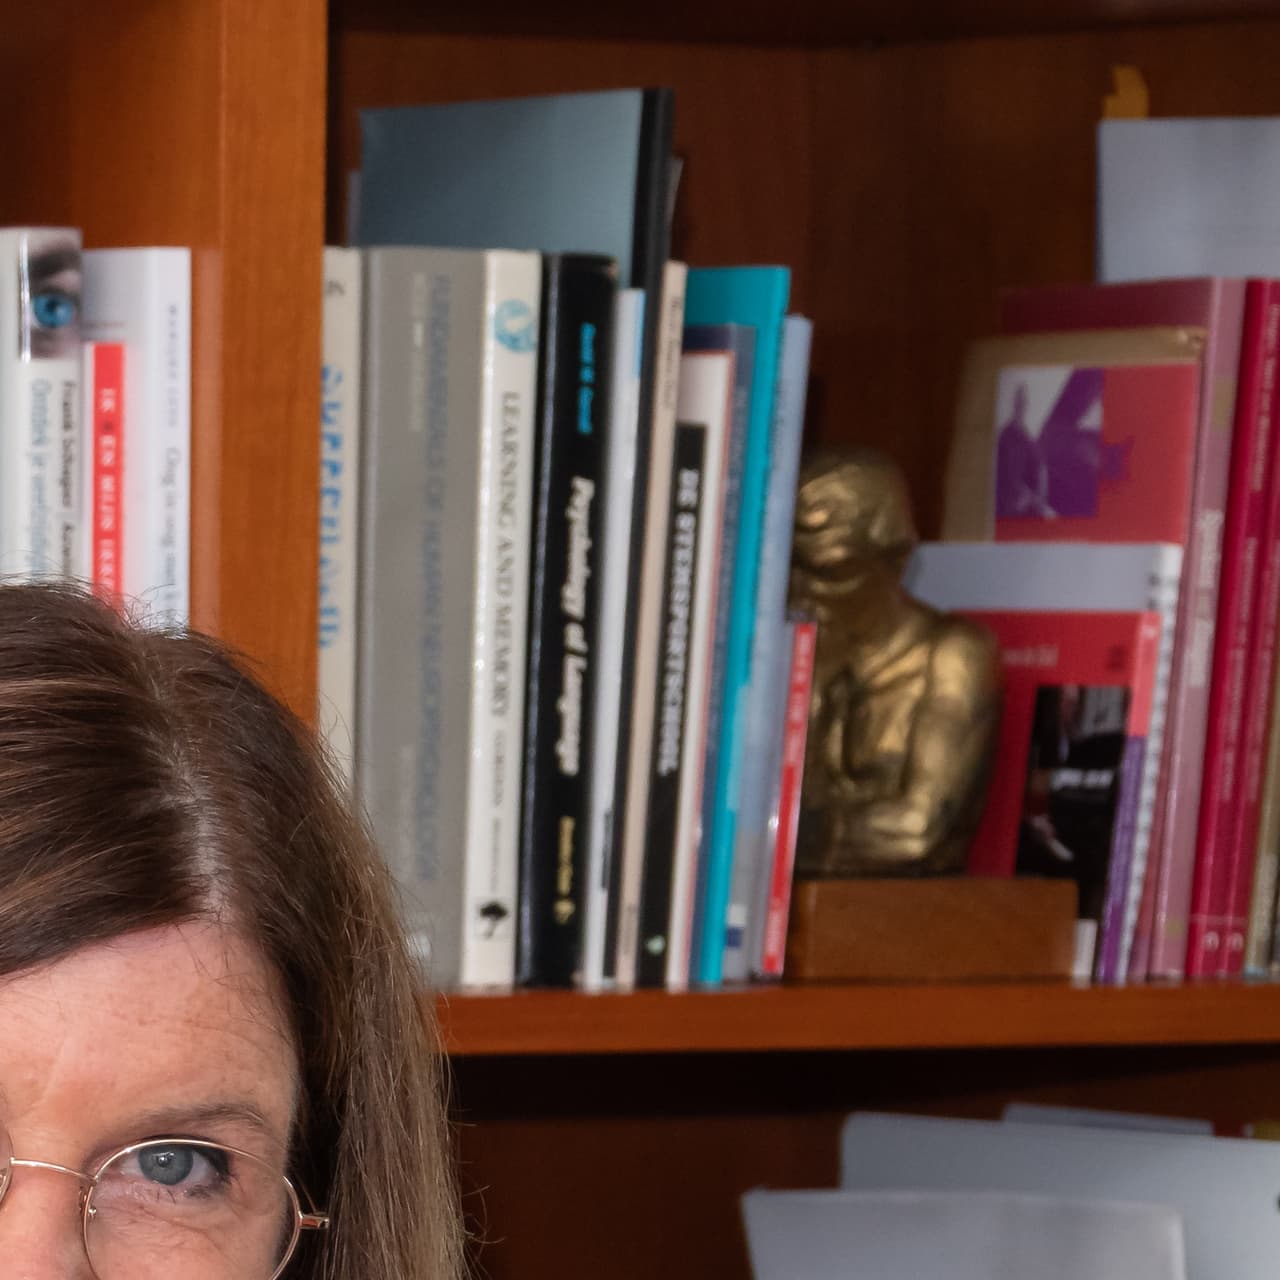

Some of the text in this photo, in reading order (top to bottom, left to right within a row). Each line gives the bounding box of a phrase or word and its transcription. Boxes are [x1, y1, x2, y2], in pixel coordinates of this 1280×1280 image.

[495, 391, 521, 529] LEARNING
[494, 535, 517, 597] AND
[560, 476, 595, 620] Psychology
[563, 622, 589, 654] of
[554, 653, 588, 777] Language
